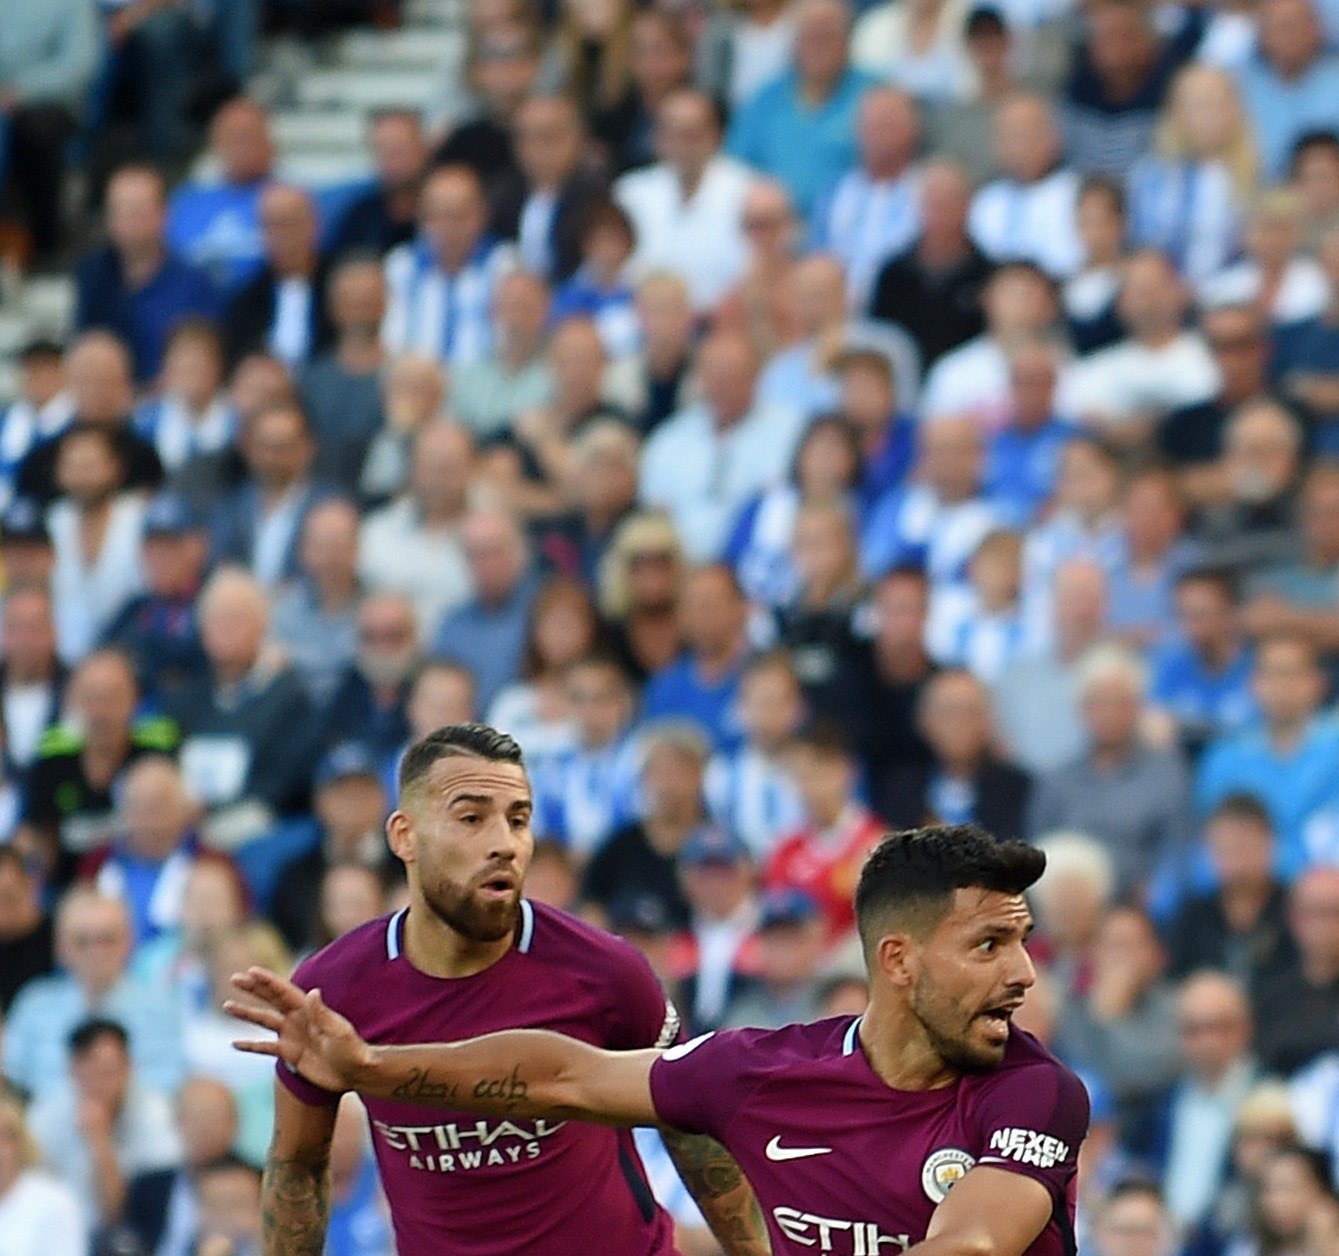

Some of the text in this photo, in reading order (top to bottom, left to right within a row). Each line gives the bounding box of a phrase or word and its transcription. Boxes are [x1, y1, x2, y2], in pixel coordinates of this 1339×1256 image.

[409, 1141, 541, 1172] AIRWAYS
[989, 1127, 1070, 1162] NEXEN
[772, 1206, 910, 1256] ETIH
